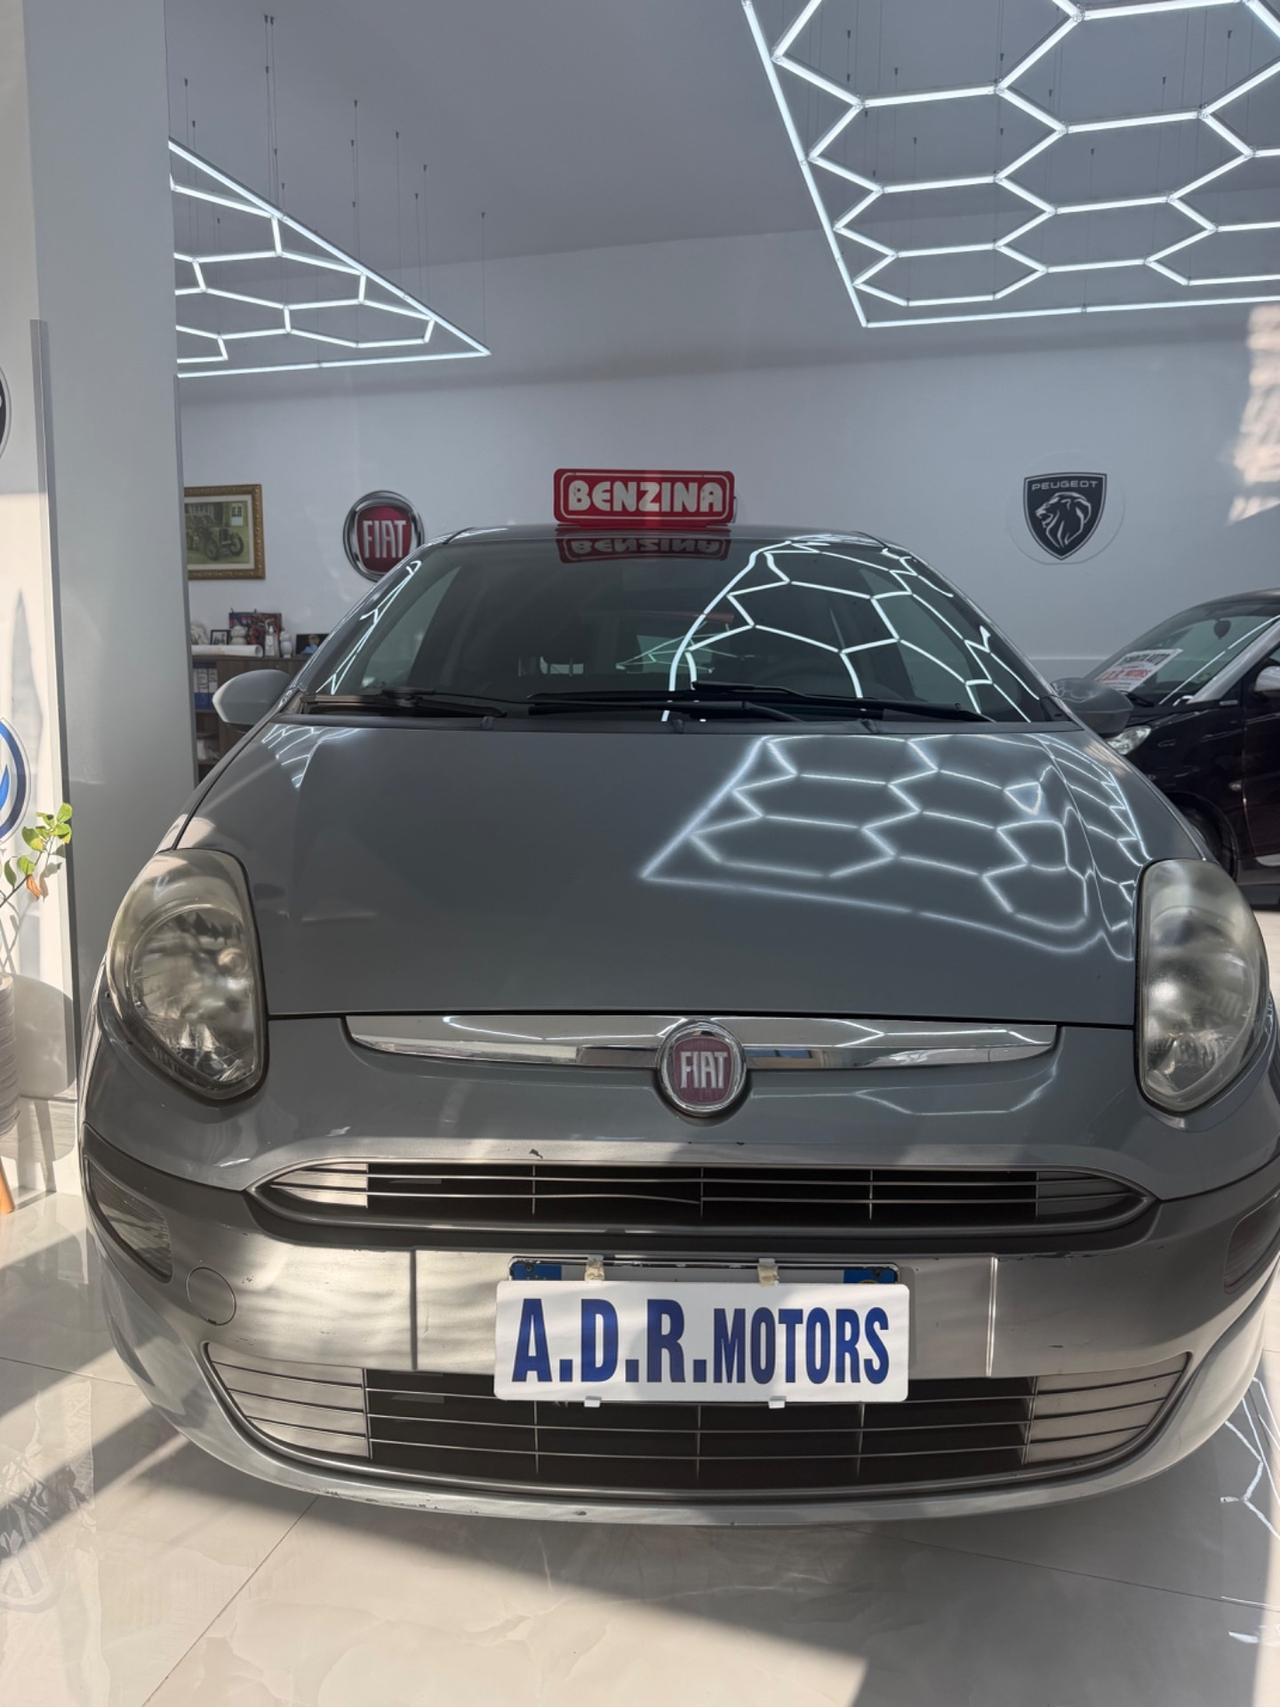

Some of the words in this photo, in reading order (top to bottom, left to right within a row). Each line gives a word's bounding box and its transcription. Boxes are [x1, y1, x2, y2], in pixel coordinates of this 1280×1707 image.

[568, 480, 724, 513] BENZINA
[1031, 481, 1099, 491] PEUGEOT
[362, 519, 409, 559] FIAT
[679, 1051, 728, 1089] FIAT
